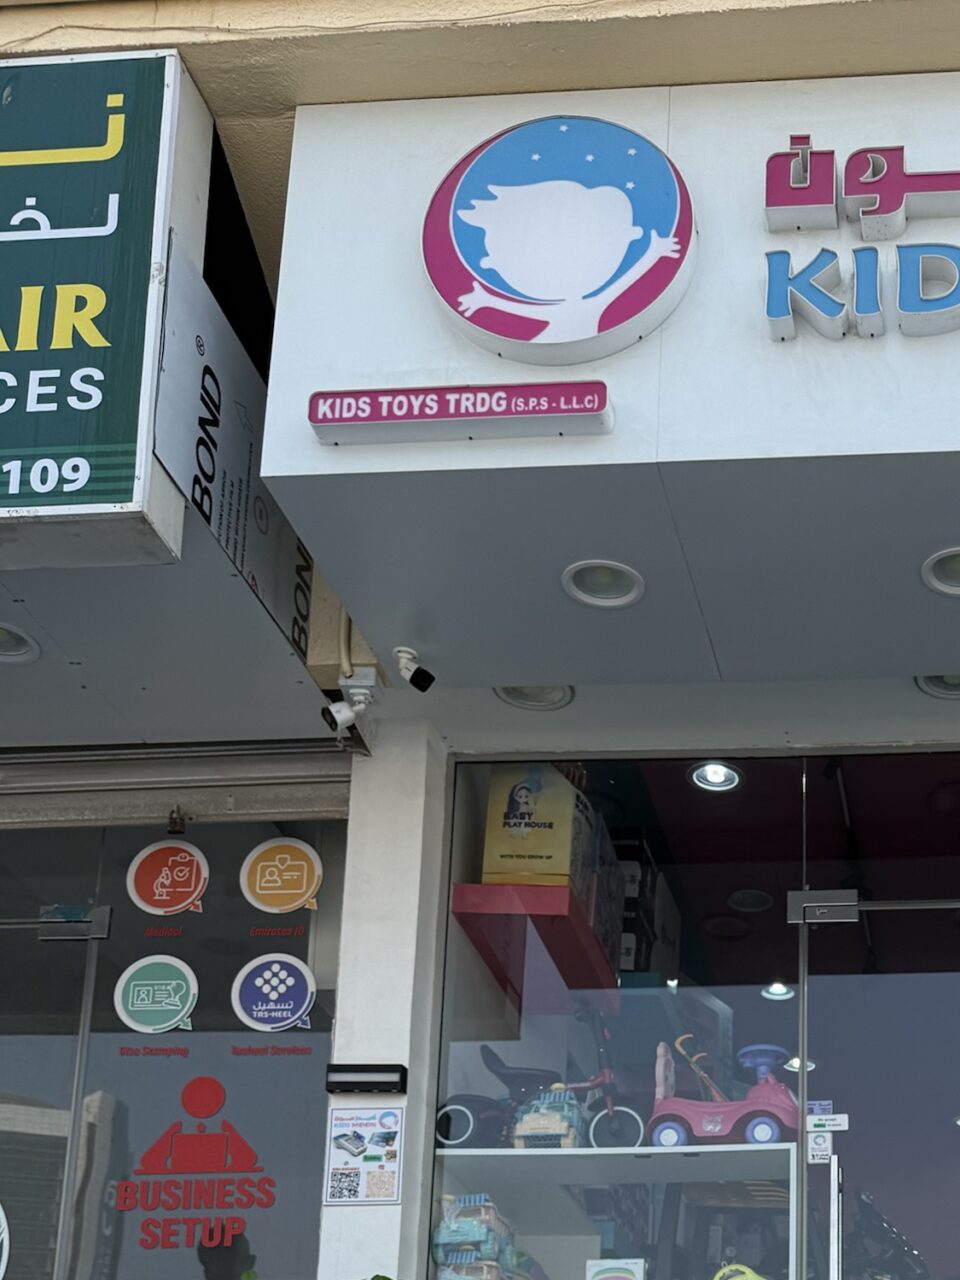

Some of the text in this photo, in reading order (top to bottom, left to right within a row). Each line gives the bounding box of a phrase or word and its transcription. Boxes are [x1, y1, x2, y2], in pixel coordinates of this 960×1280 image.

[0, 283, 112, 352] IR
[317, 396, 371, 420] KIDS
[377, 394, 439, 417] TOYS
[445, 390, 507, 414] TRDG
[191, 364, 222, 528] BOND
[292, 536, 314, 665] BON
[503, 811, 533, 821] BABY
[524, 821, 554, 830] HOUSE
[116, 1176, 276, 1212] BUSINESS
[138, 1216, 247, 1250] SETUP
